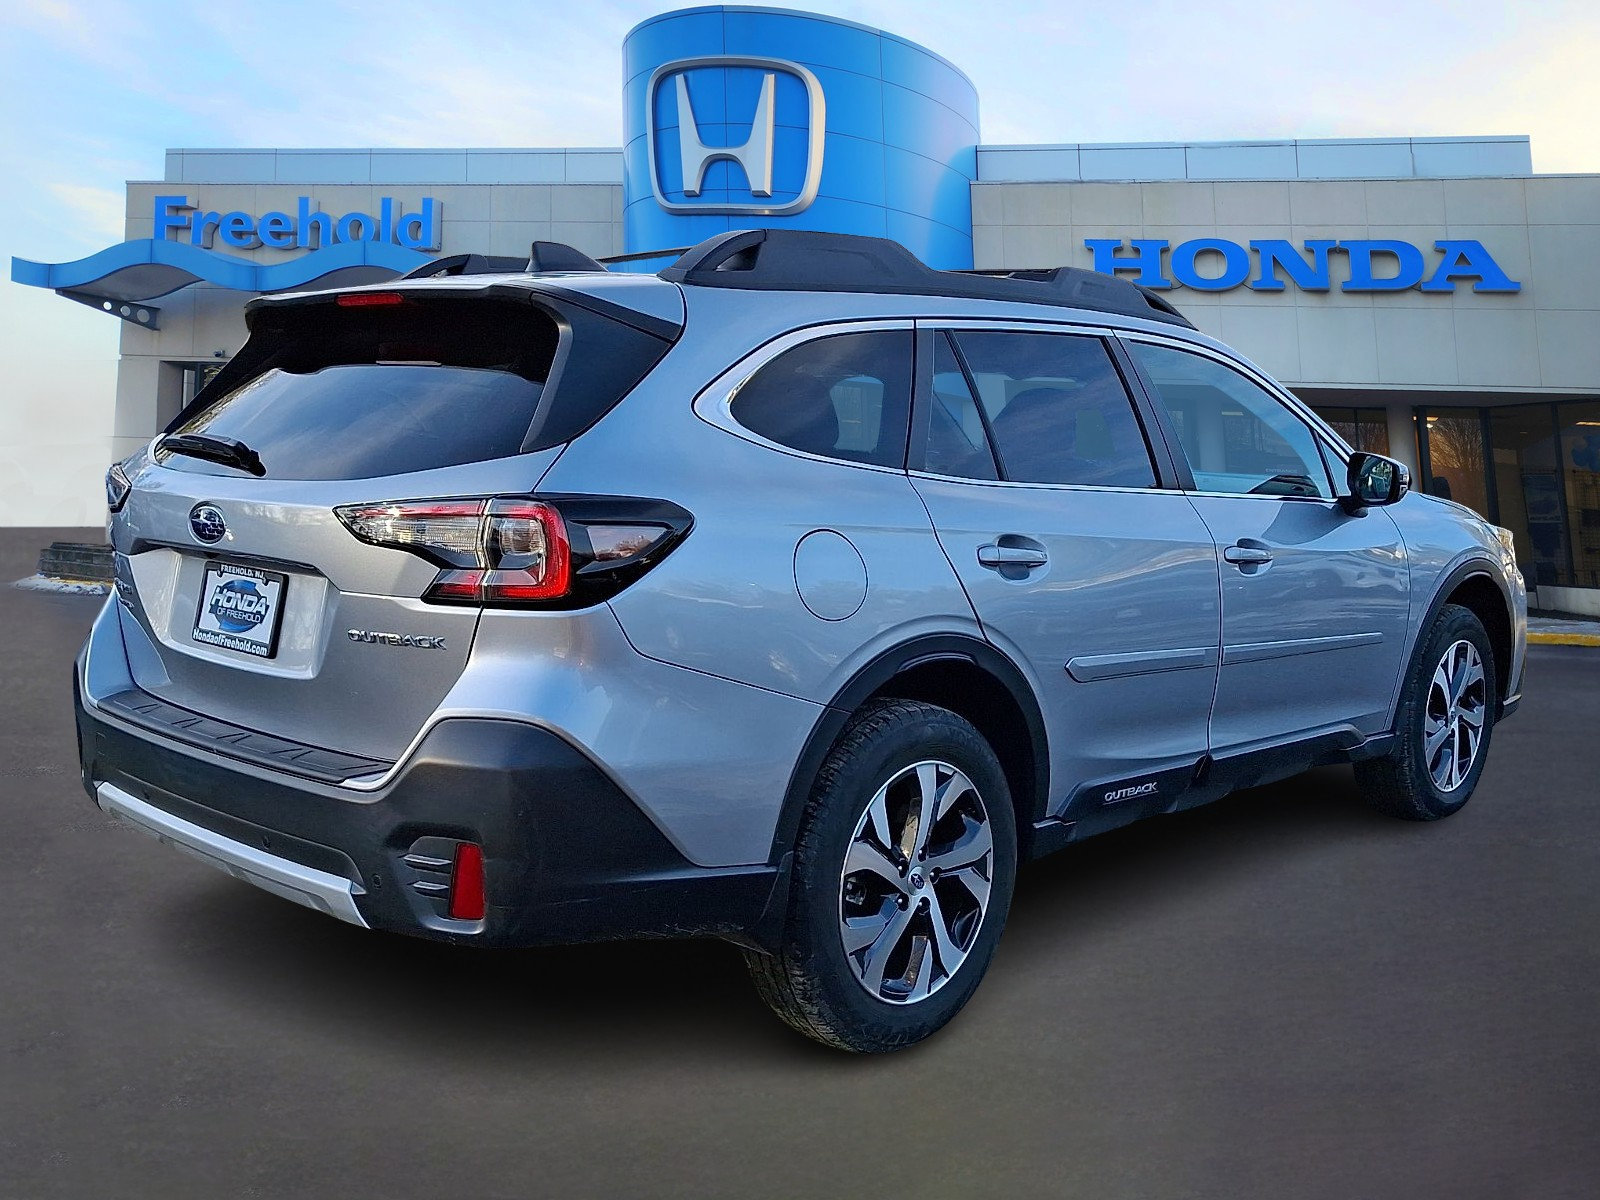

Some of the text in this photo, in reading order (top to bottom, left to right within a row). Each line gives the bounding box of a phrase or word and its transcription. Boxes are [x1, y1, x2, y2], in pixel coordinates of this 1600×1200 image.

[154, 196, 443, 251] Freehold
[1084, 238, 1522, 293] HONDA
[211, 586, 267, 616] HONDA
[217, 607, 261, 623] OF FREEHOLD
[192, 628, 268, 656] HondaofFreehold.com
[347, 628, 448, 651] OUTBACK
[1104, 781, 1158, 802] OUTBACK
